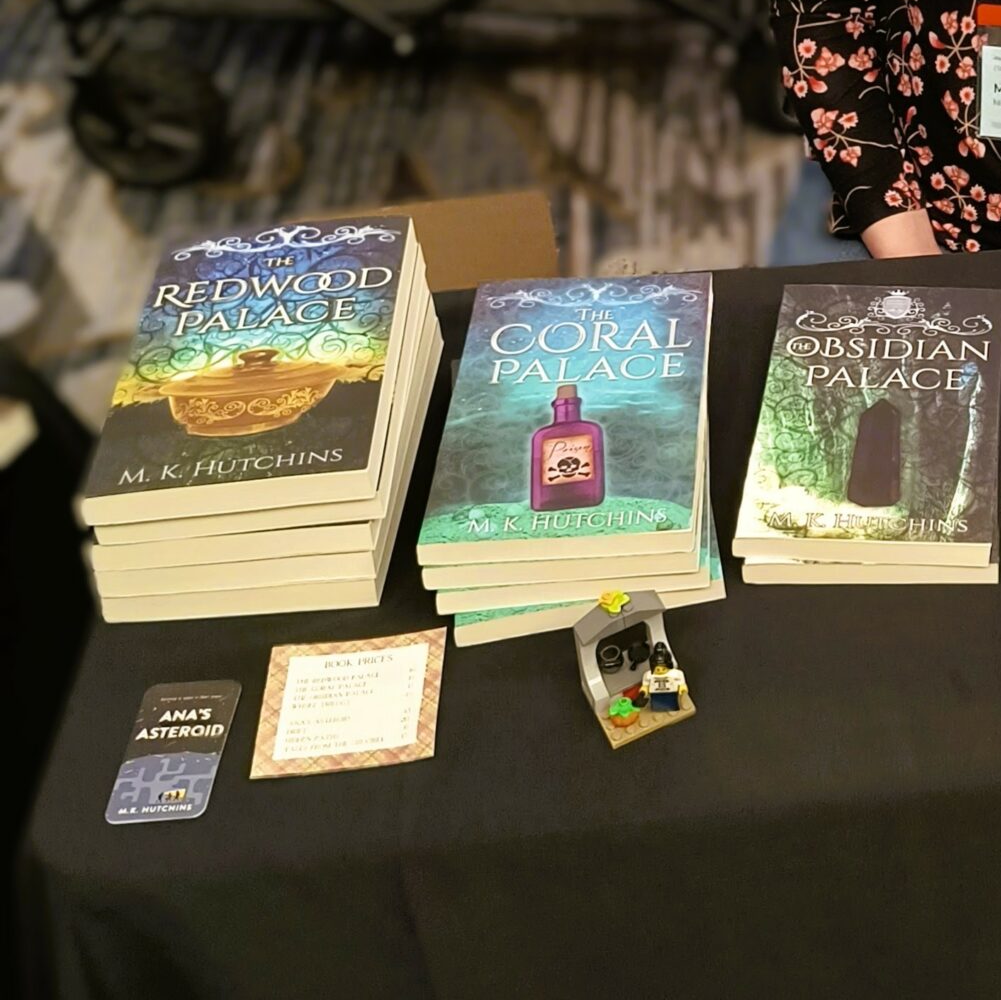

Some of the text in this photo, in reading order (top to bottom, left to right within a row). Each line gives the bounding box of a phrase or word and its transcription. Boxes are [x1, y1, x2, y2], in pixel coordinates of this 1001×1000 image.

[263, 256, 295, 269] THE
[153, 266, 393, 310] REDWOOD
[174, 297, 357, 337] PALACE
[574, 308, 614, 322] THE
[490, 318, 693, 355] CORAL
[786, 335, 991, 362] OBSIDIAN
[791, 342, 813, 351] THE
[488, 352, 687, 385] PALACE
[805, 365, 967, 391] PALACE
[118, 448, 344, 486] M. K. HUTCHINS
[467, 507, 668, 533] M. K. HUTCHINS
[832, 513, 969, 533] HUTCHINS
[324, 654, 393, 669] BOOK PRICES
[158, 708, 212, 723] ANA'S
[135, 724, 225, 741] ASTEROID
